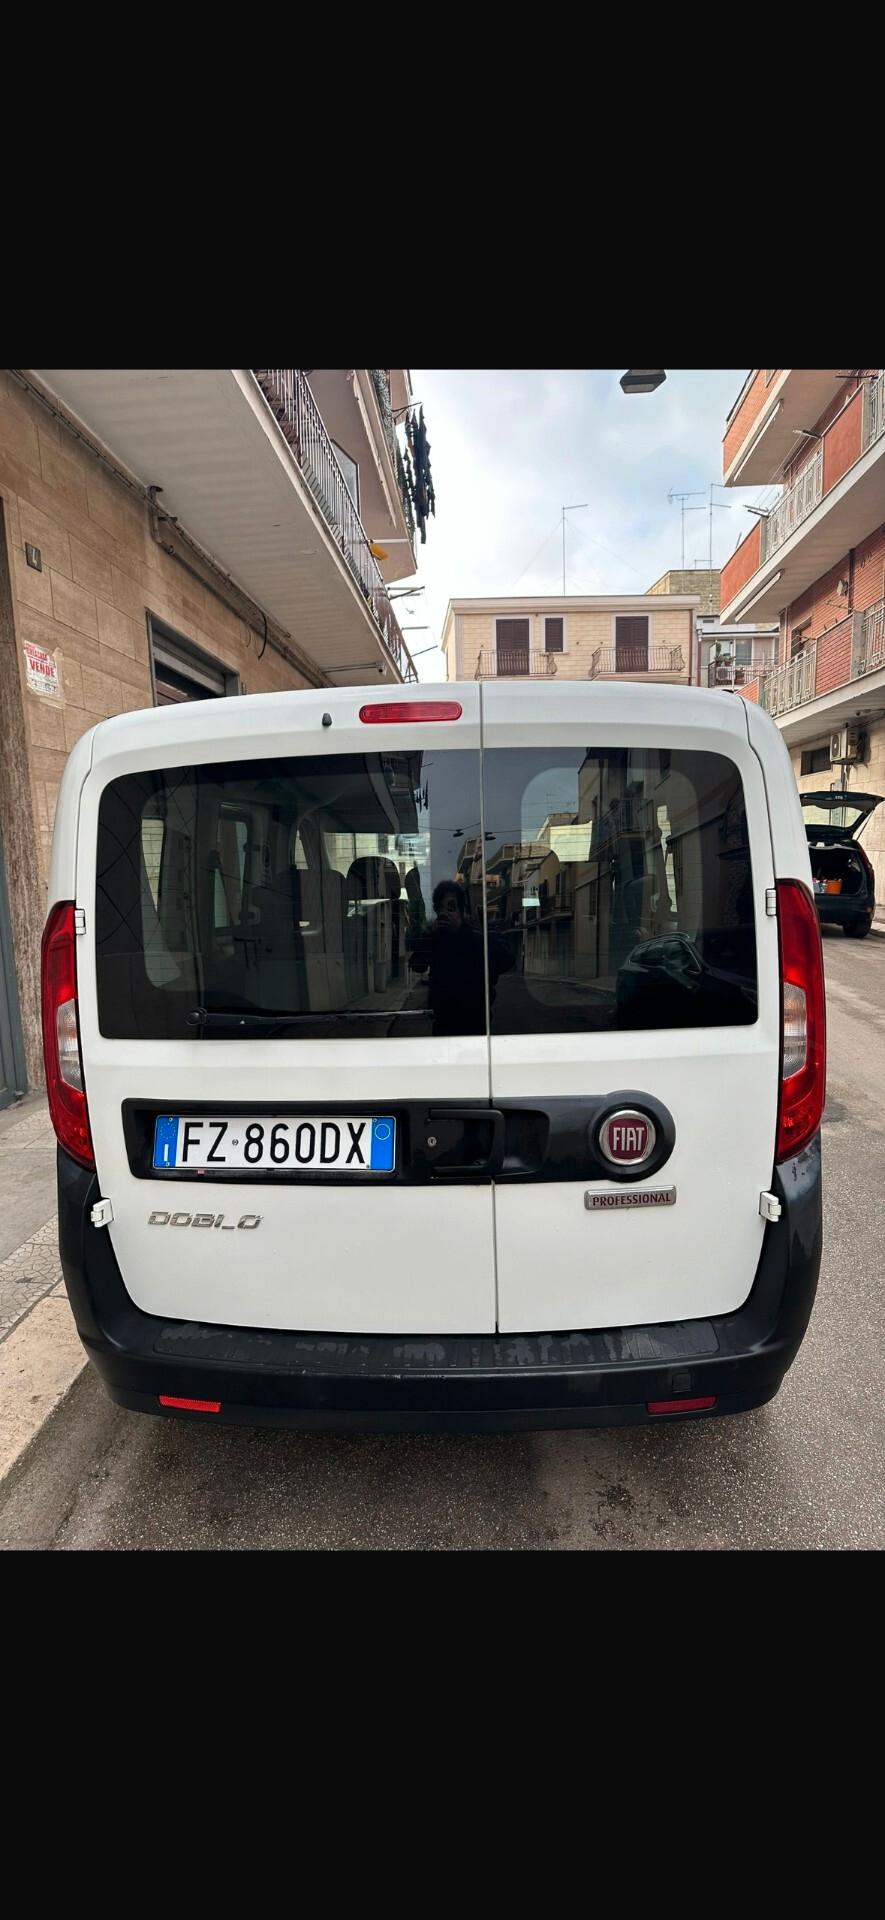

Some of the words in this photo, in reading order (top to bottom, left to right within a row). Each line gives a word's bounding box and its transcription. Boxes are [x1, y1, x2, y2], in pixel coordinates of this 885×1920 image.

[29, 659, 56, 678] VENDE
[182, 1122, 229, 1162] FZ
[243, 1122, 367, 1164] 860DX
[613, 1127, 645, 1152] FIAT
[592, 1193, 671, 1206] PROFESSIONAL
